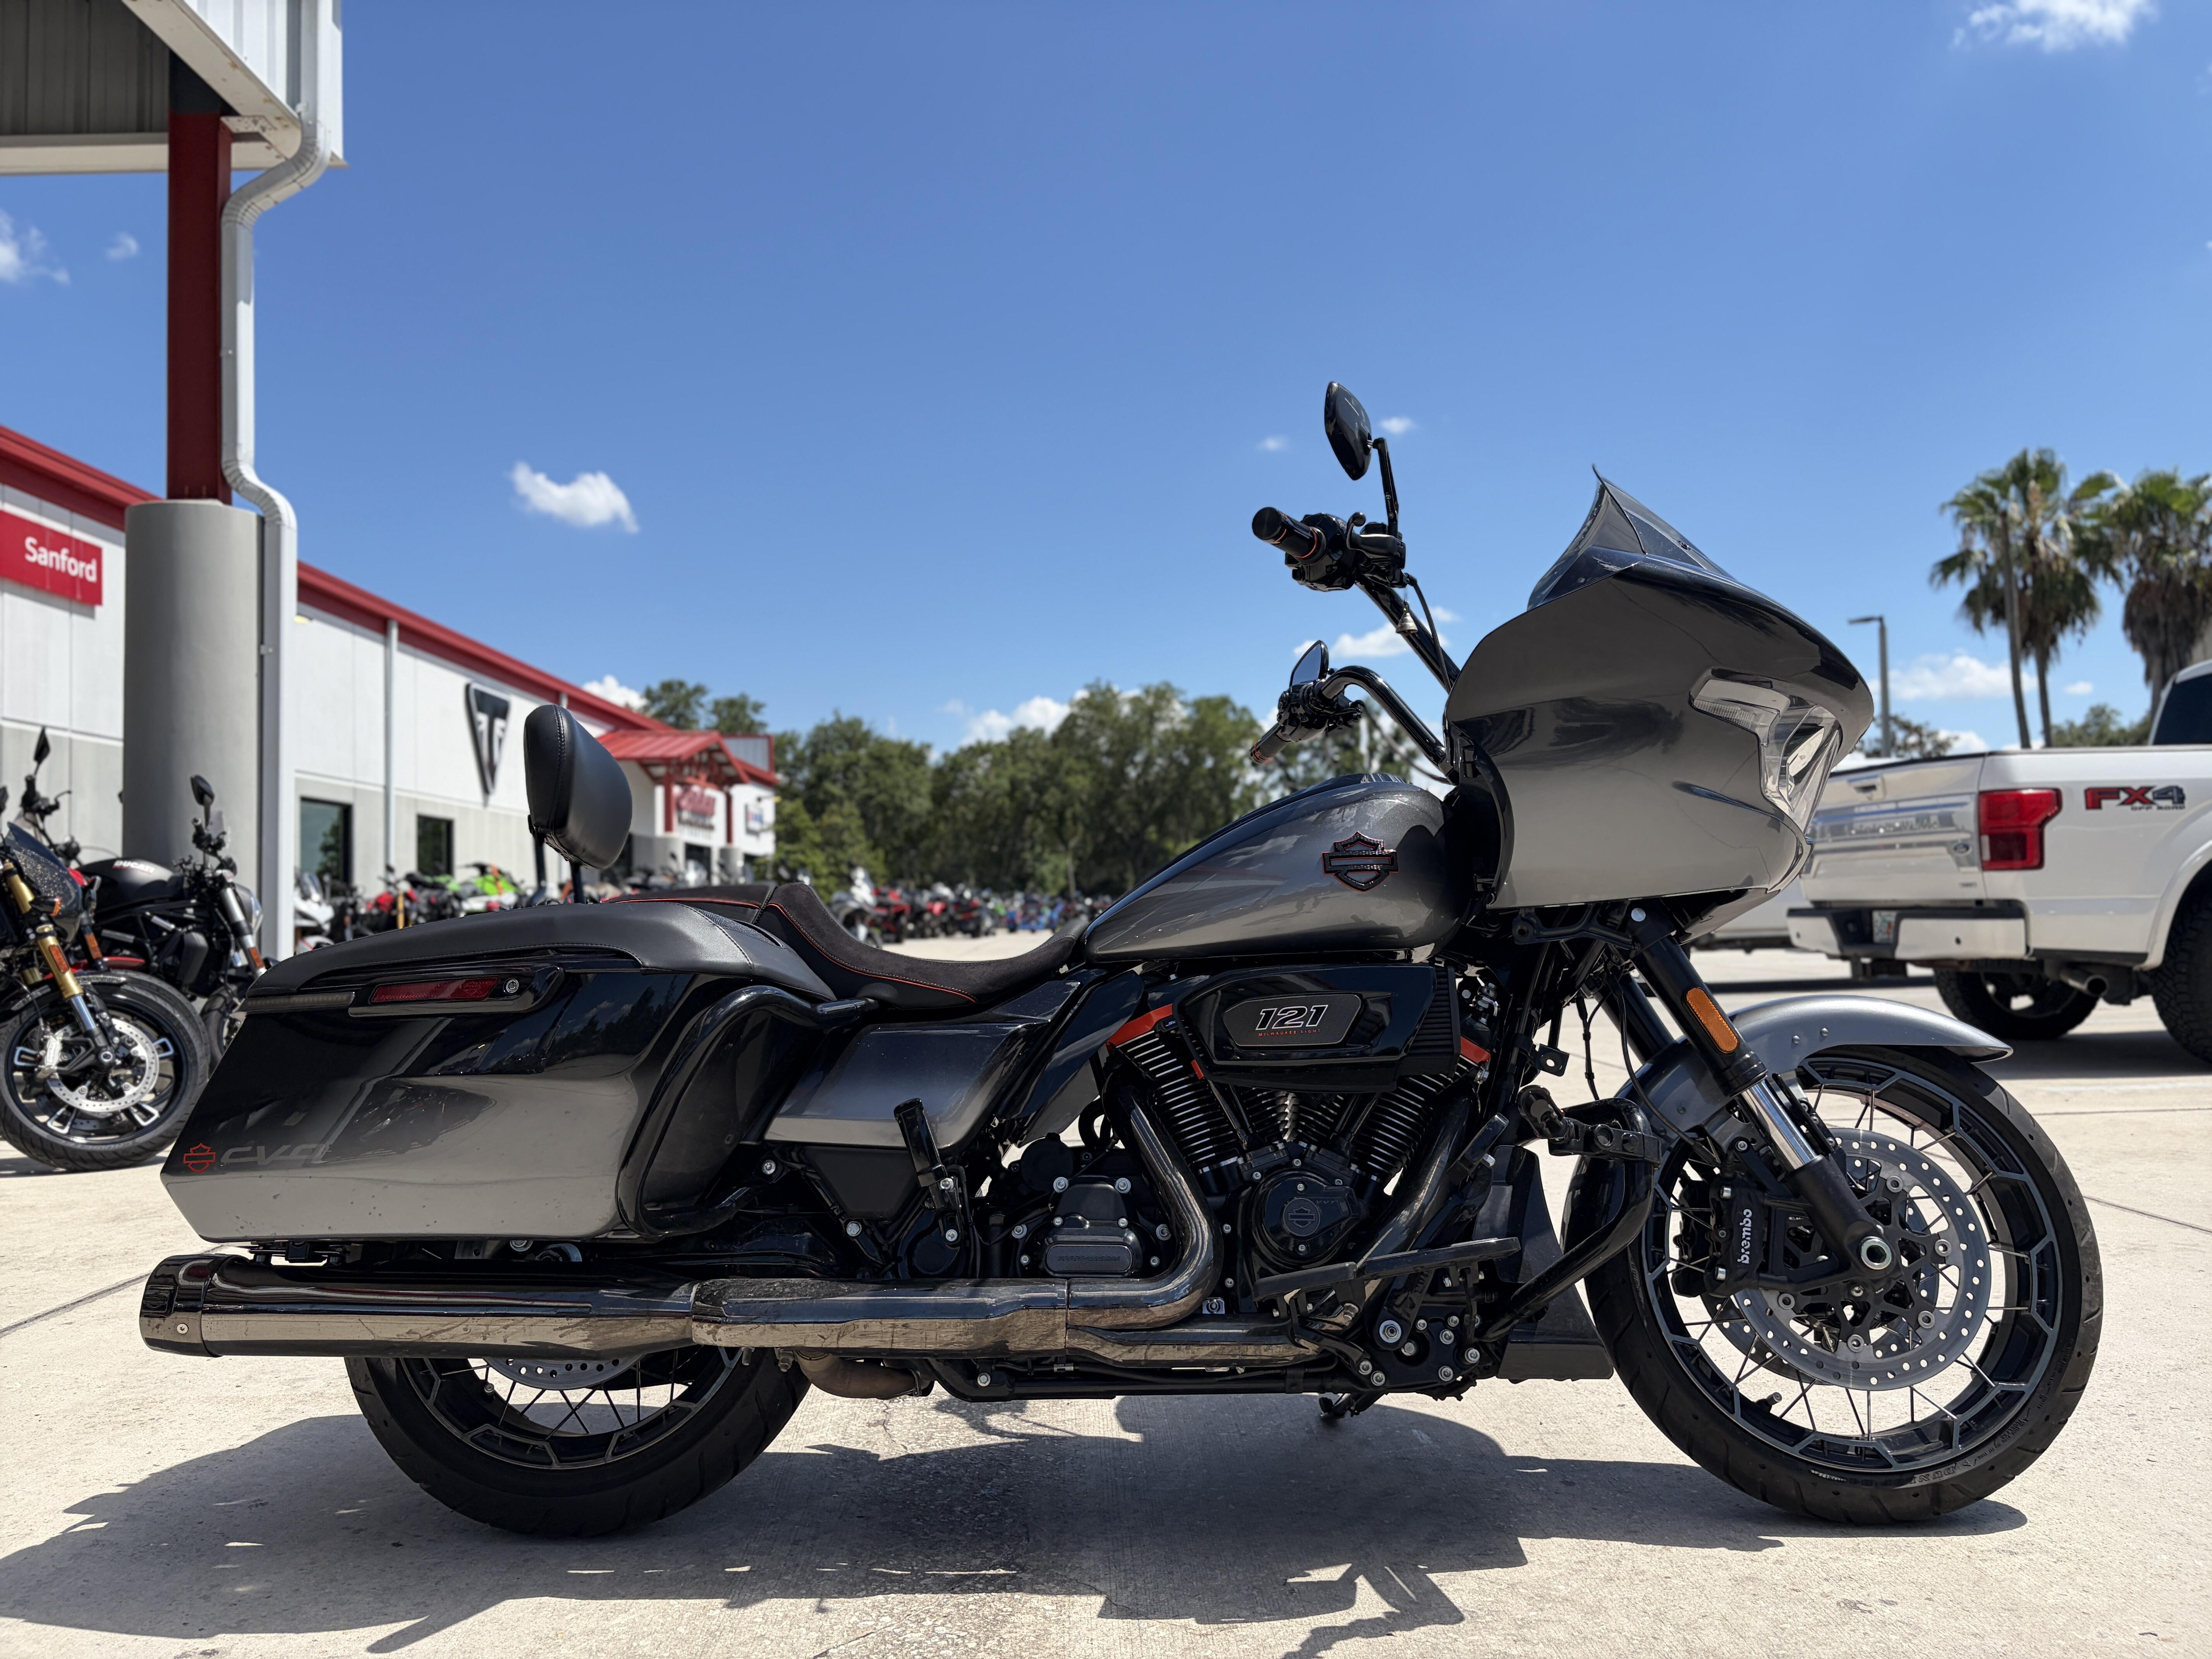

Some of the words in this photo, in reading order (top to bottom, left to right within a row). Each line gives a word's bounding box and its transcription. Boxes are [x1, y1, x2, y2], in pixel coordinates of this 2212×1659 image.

[25, 536, 96, 583] Sanford
[2084, 786, 2185, 811] FX4
[114, 860, 155, 874] DUCATI
[1255, 1005, 1328, 1030] 121
[1737, 1209, 1752, 1264] brembo
